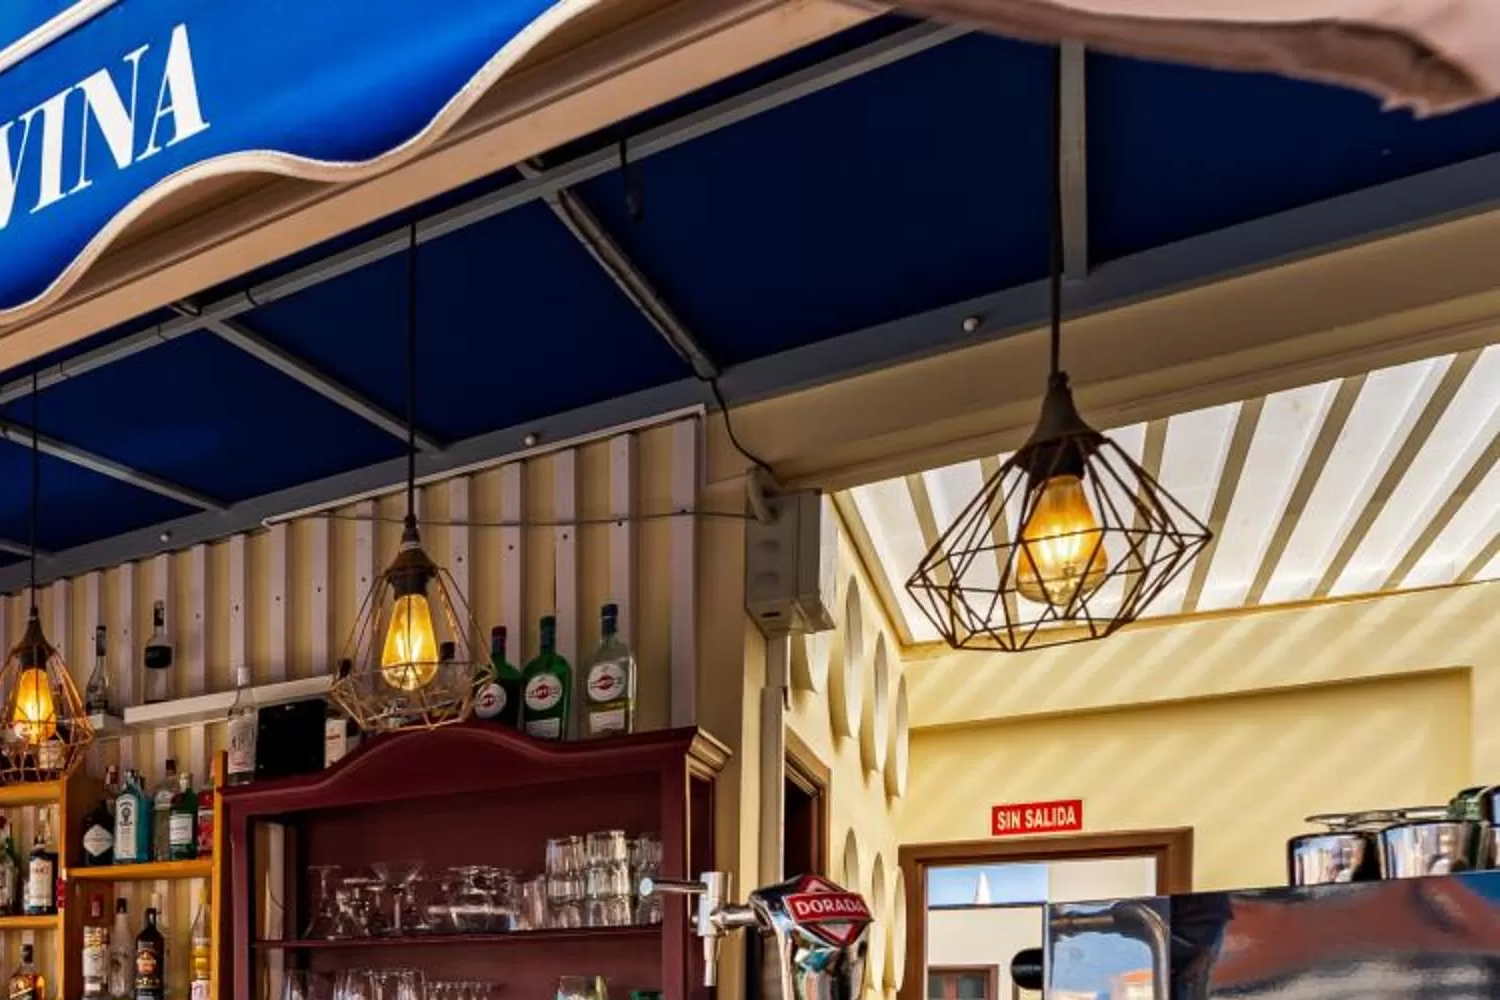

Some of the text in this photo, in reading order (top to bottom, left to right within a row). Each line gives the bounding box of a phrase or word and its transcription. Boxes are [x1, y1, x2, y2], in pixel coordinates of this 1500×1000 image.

[997, 805, 1077, 831] SIN SALIDA
[795, 898, 867, 915] DORADA
